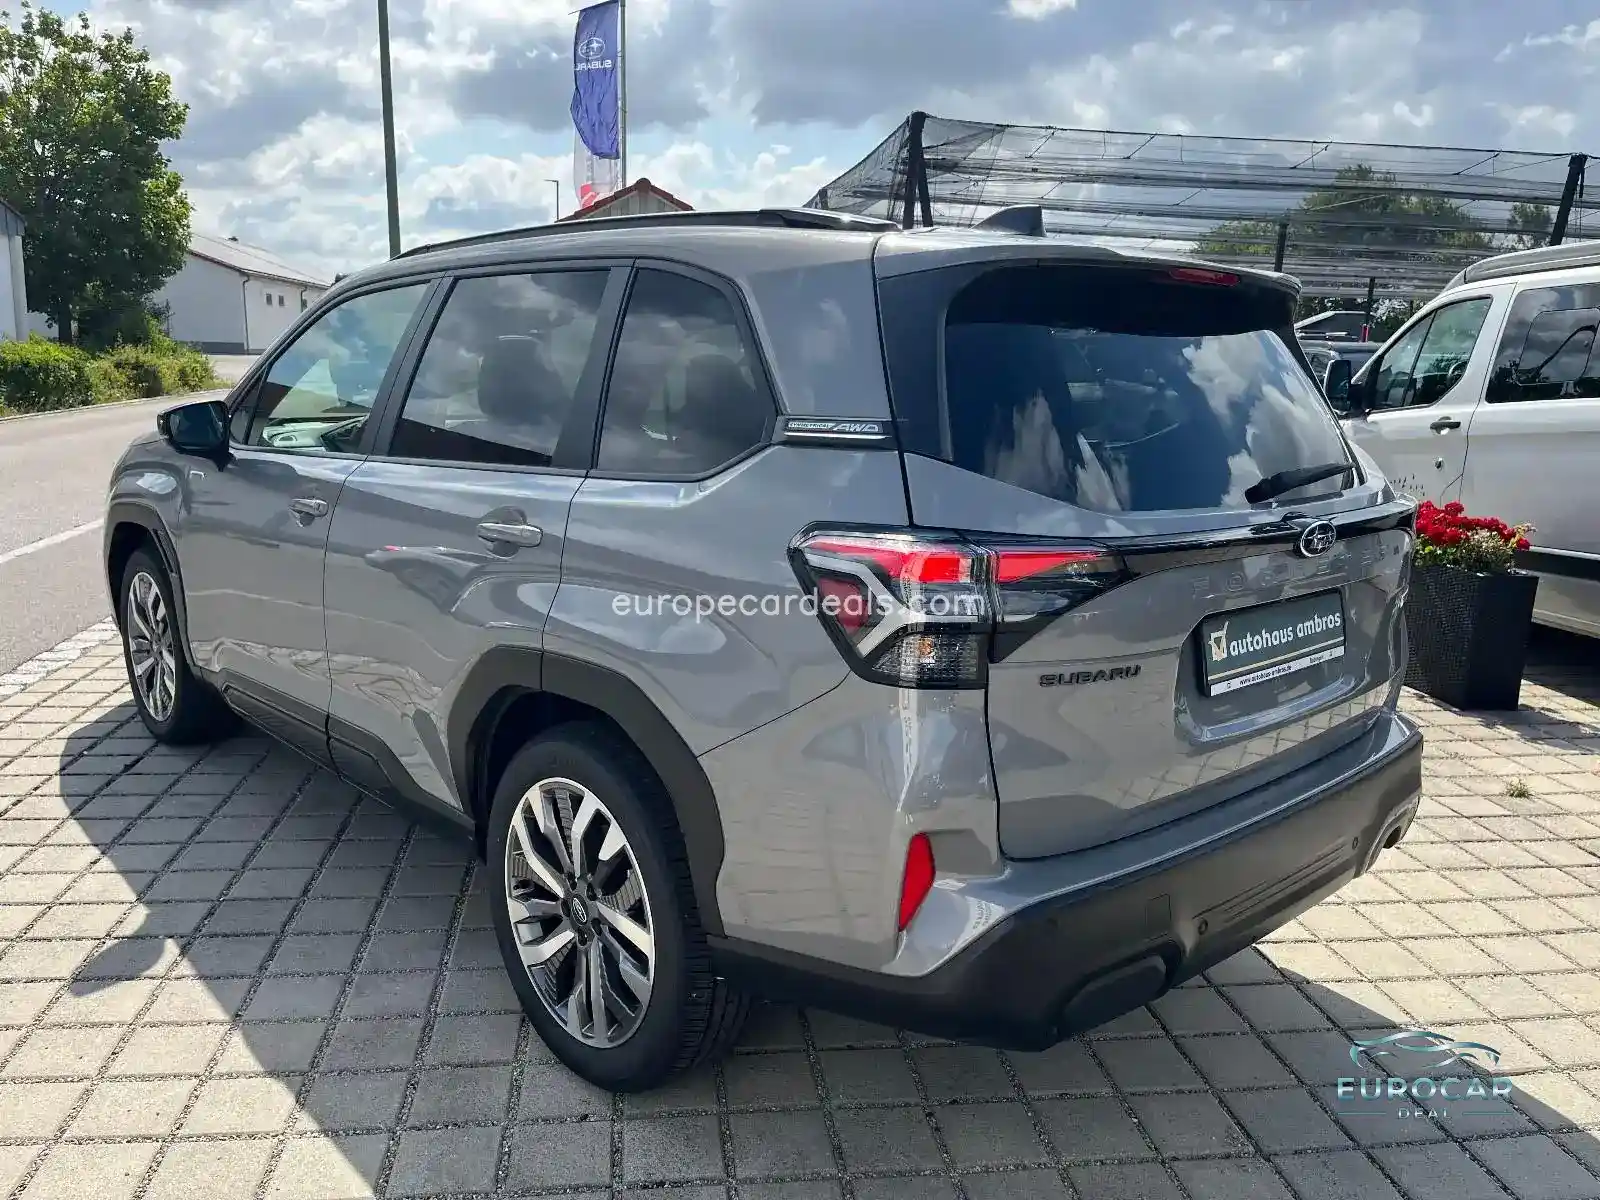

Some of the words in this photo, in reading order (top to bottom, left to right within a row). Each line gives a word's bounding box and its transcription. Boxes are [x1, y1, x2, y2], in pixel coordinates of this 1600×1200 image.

[833, 423, 880, 432] AWD
[1229, 626, 1294, 656] autohaus
[1296, 611, 1341, 637] ambros
[1039, 664, 1142, 687] SUBARU
